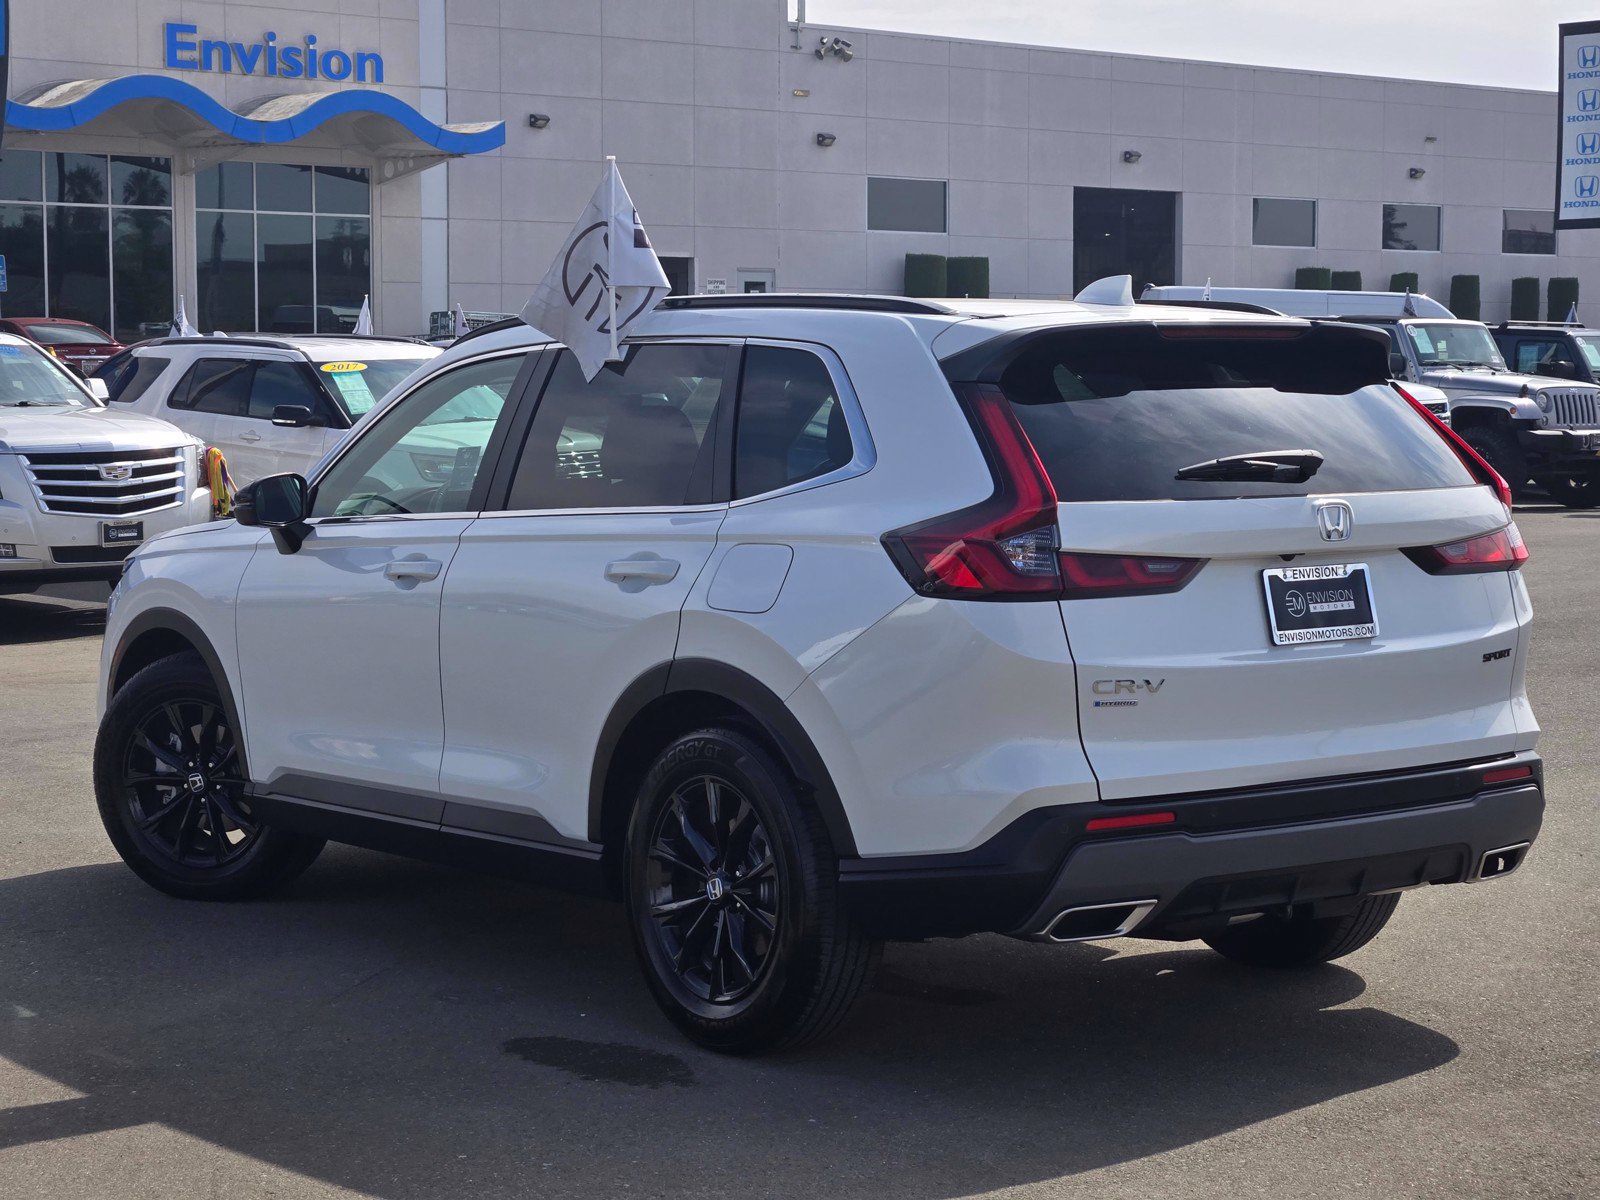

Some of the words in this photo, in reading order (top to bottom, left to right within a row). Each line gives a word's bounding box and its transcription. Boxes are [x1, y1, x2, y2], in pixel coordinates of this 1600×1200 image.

[163, 22, 384, 84] Envision
[1292, 567, 1338, 579] ENVISION
[1306, 589, 1353, 603] ENVISION
[1312, 603, 1351, 611] MOTORS
[1279, 626, 1374, 642] ENVISIONMOTORS.COM
[1483, 648, 1512, 662] SPORT
[1092, 679, 1166, 694] CR-V
